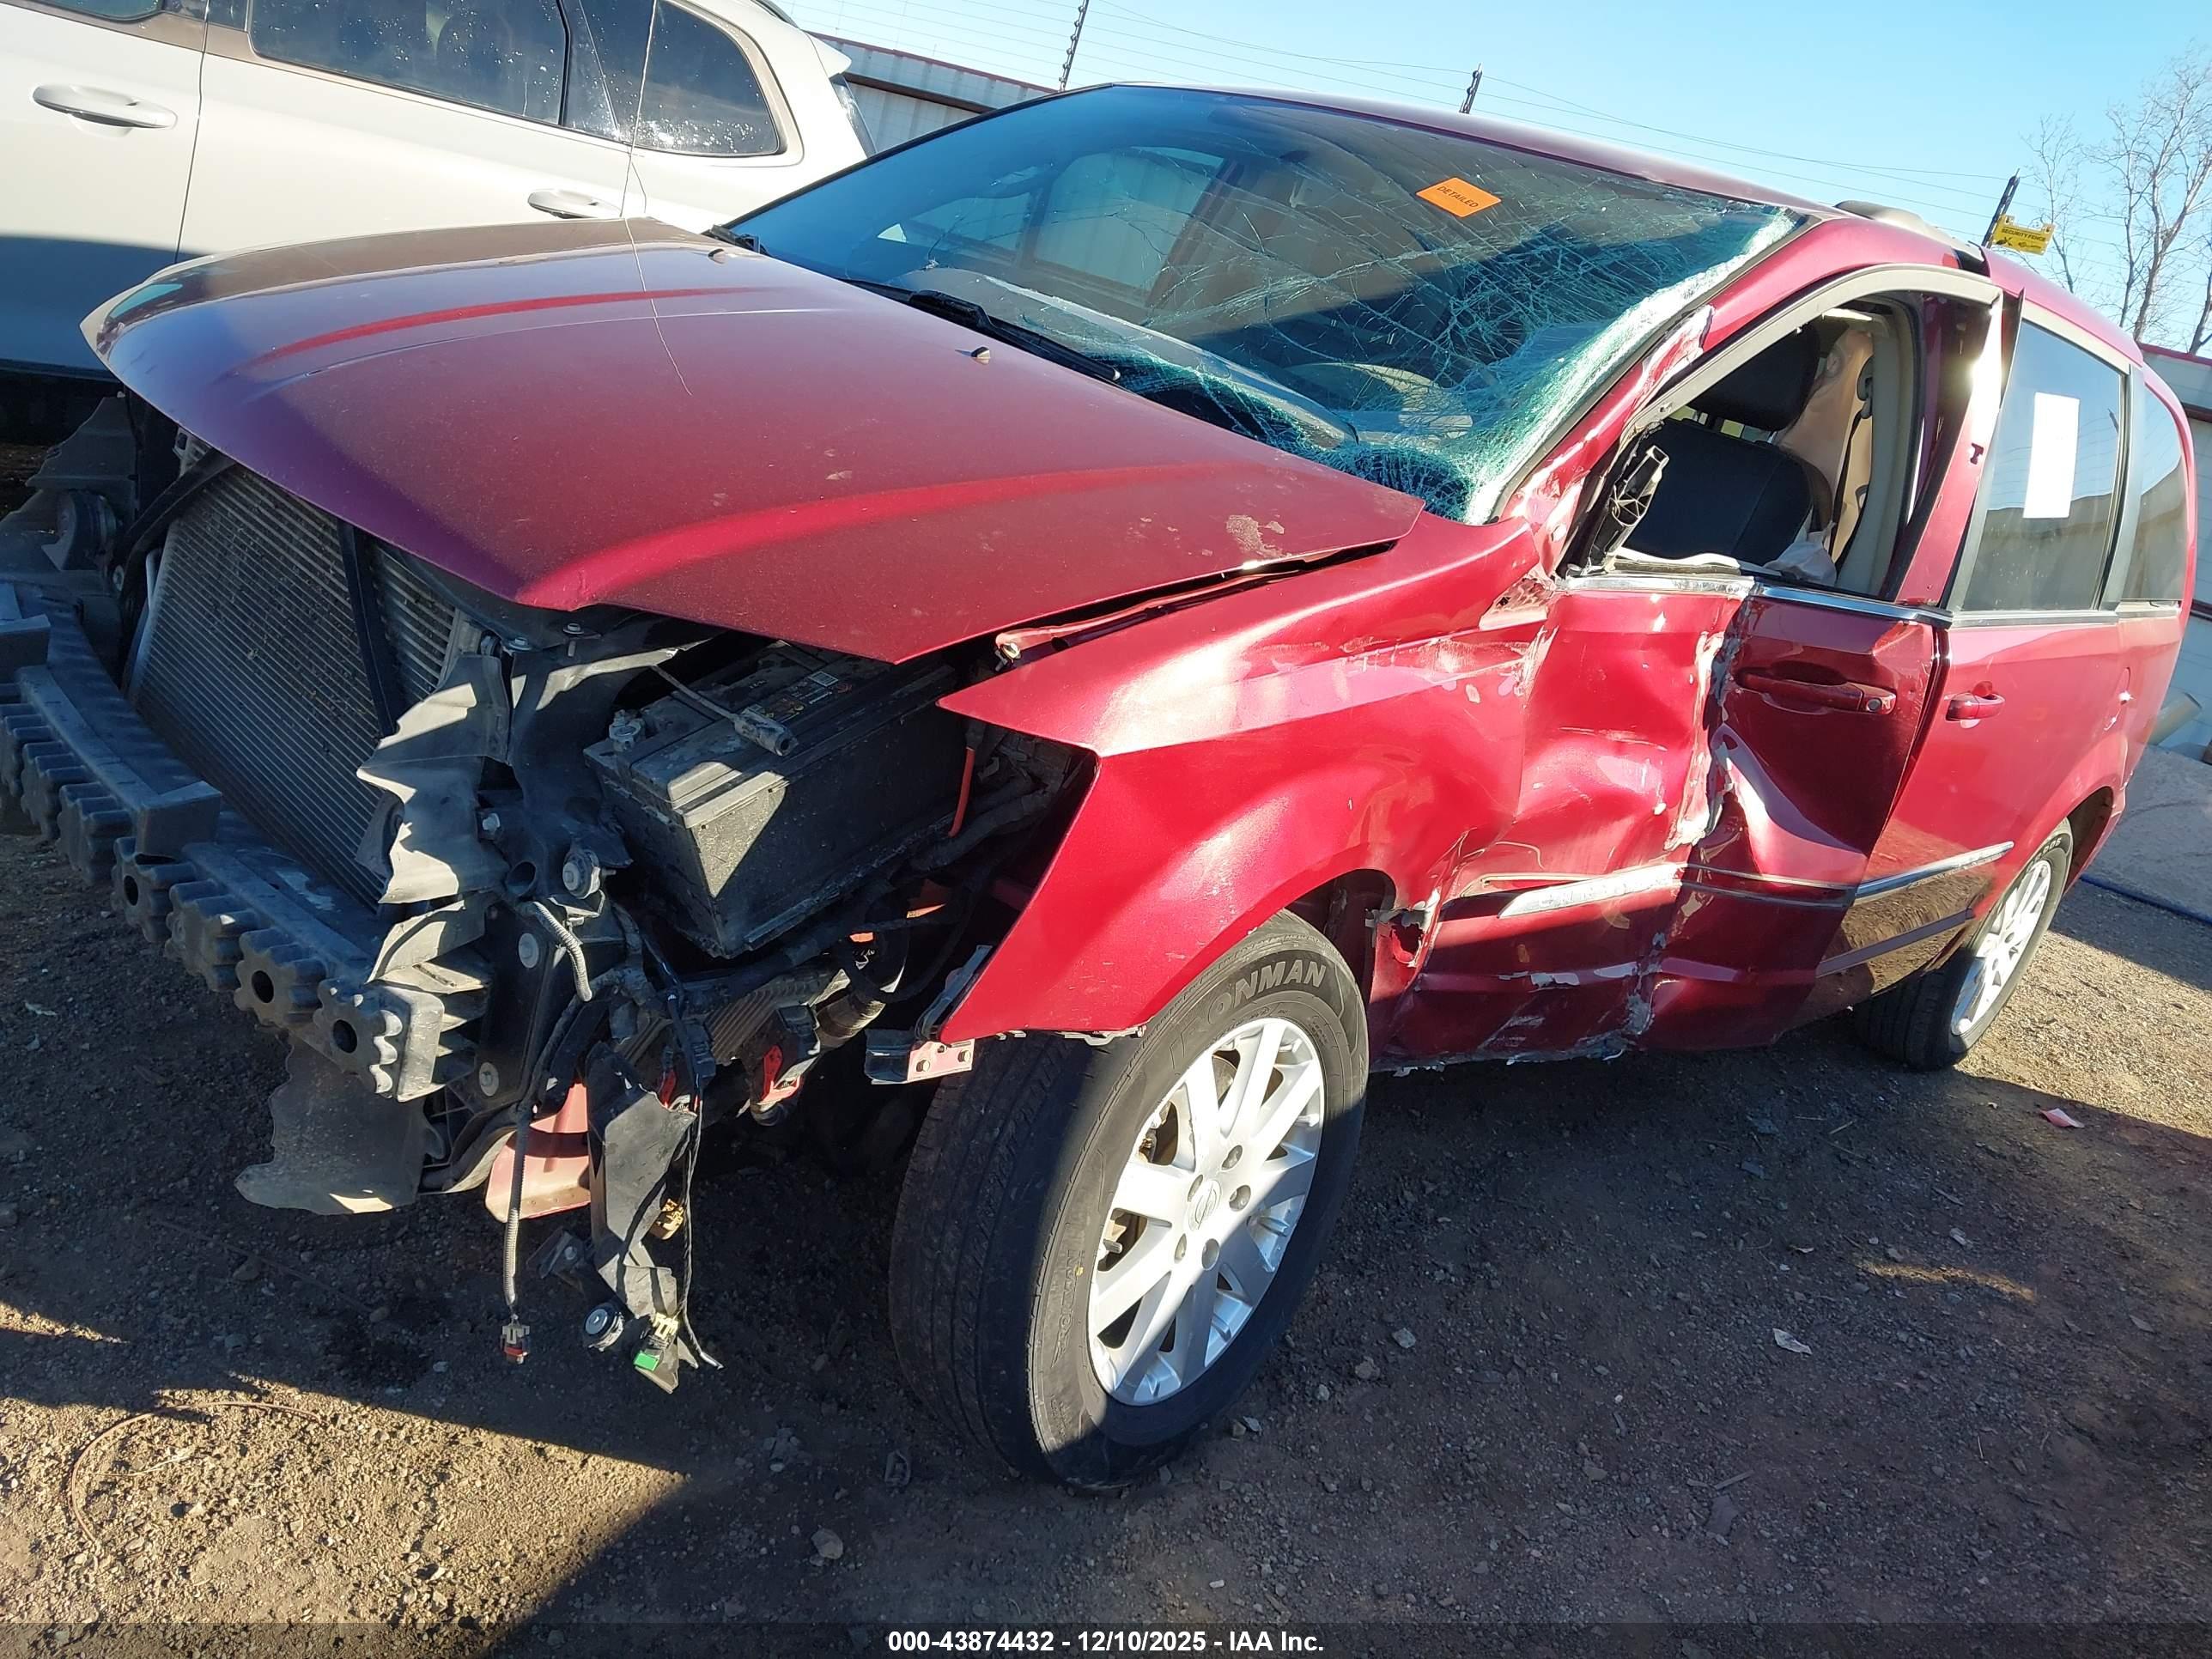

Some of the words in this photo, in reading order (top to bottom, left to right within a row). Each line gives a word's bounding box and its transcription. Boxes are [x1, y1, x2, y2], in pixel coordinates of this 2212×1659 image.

[1437, 185, 1480, 208] DETAILED
[2001, 228, 2027, 238] SECURITY
[2027, 233, 2046, 241] FENCE
